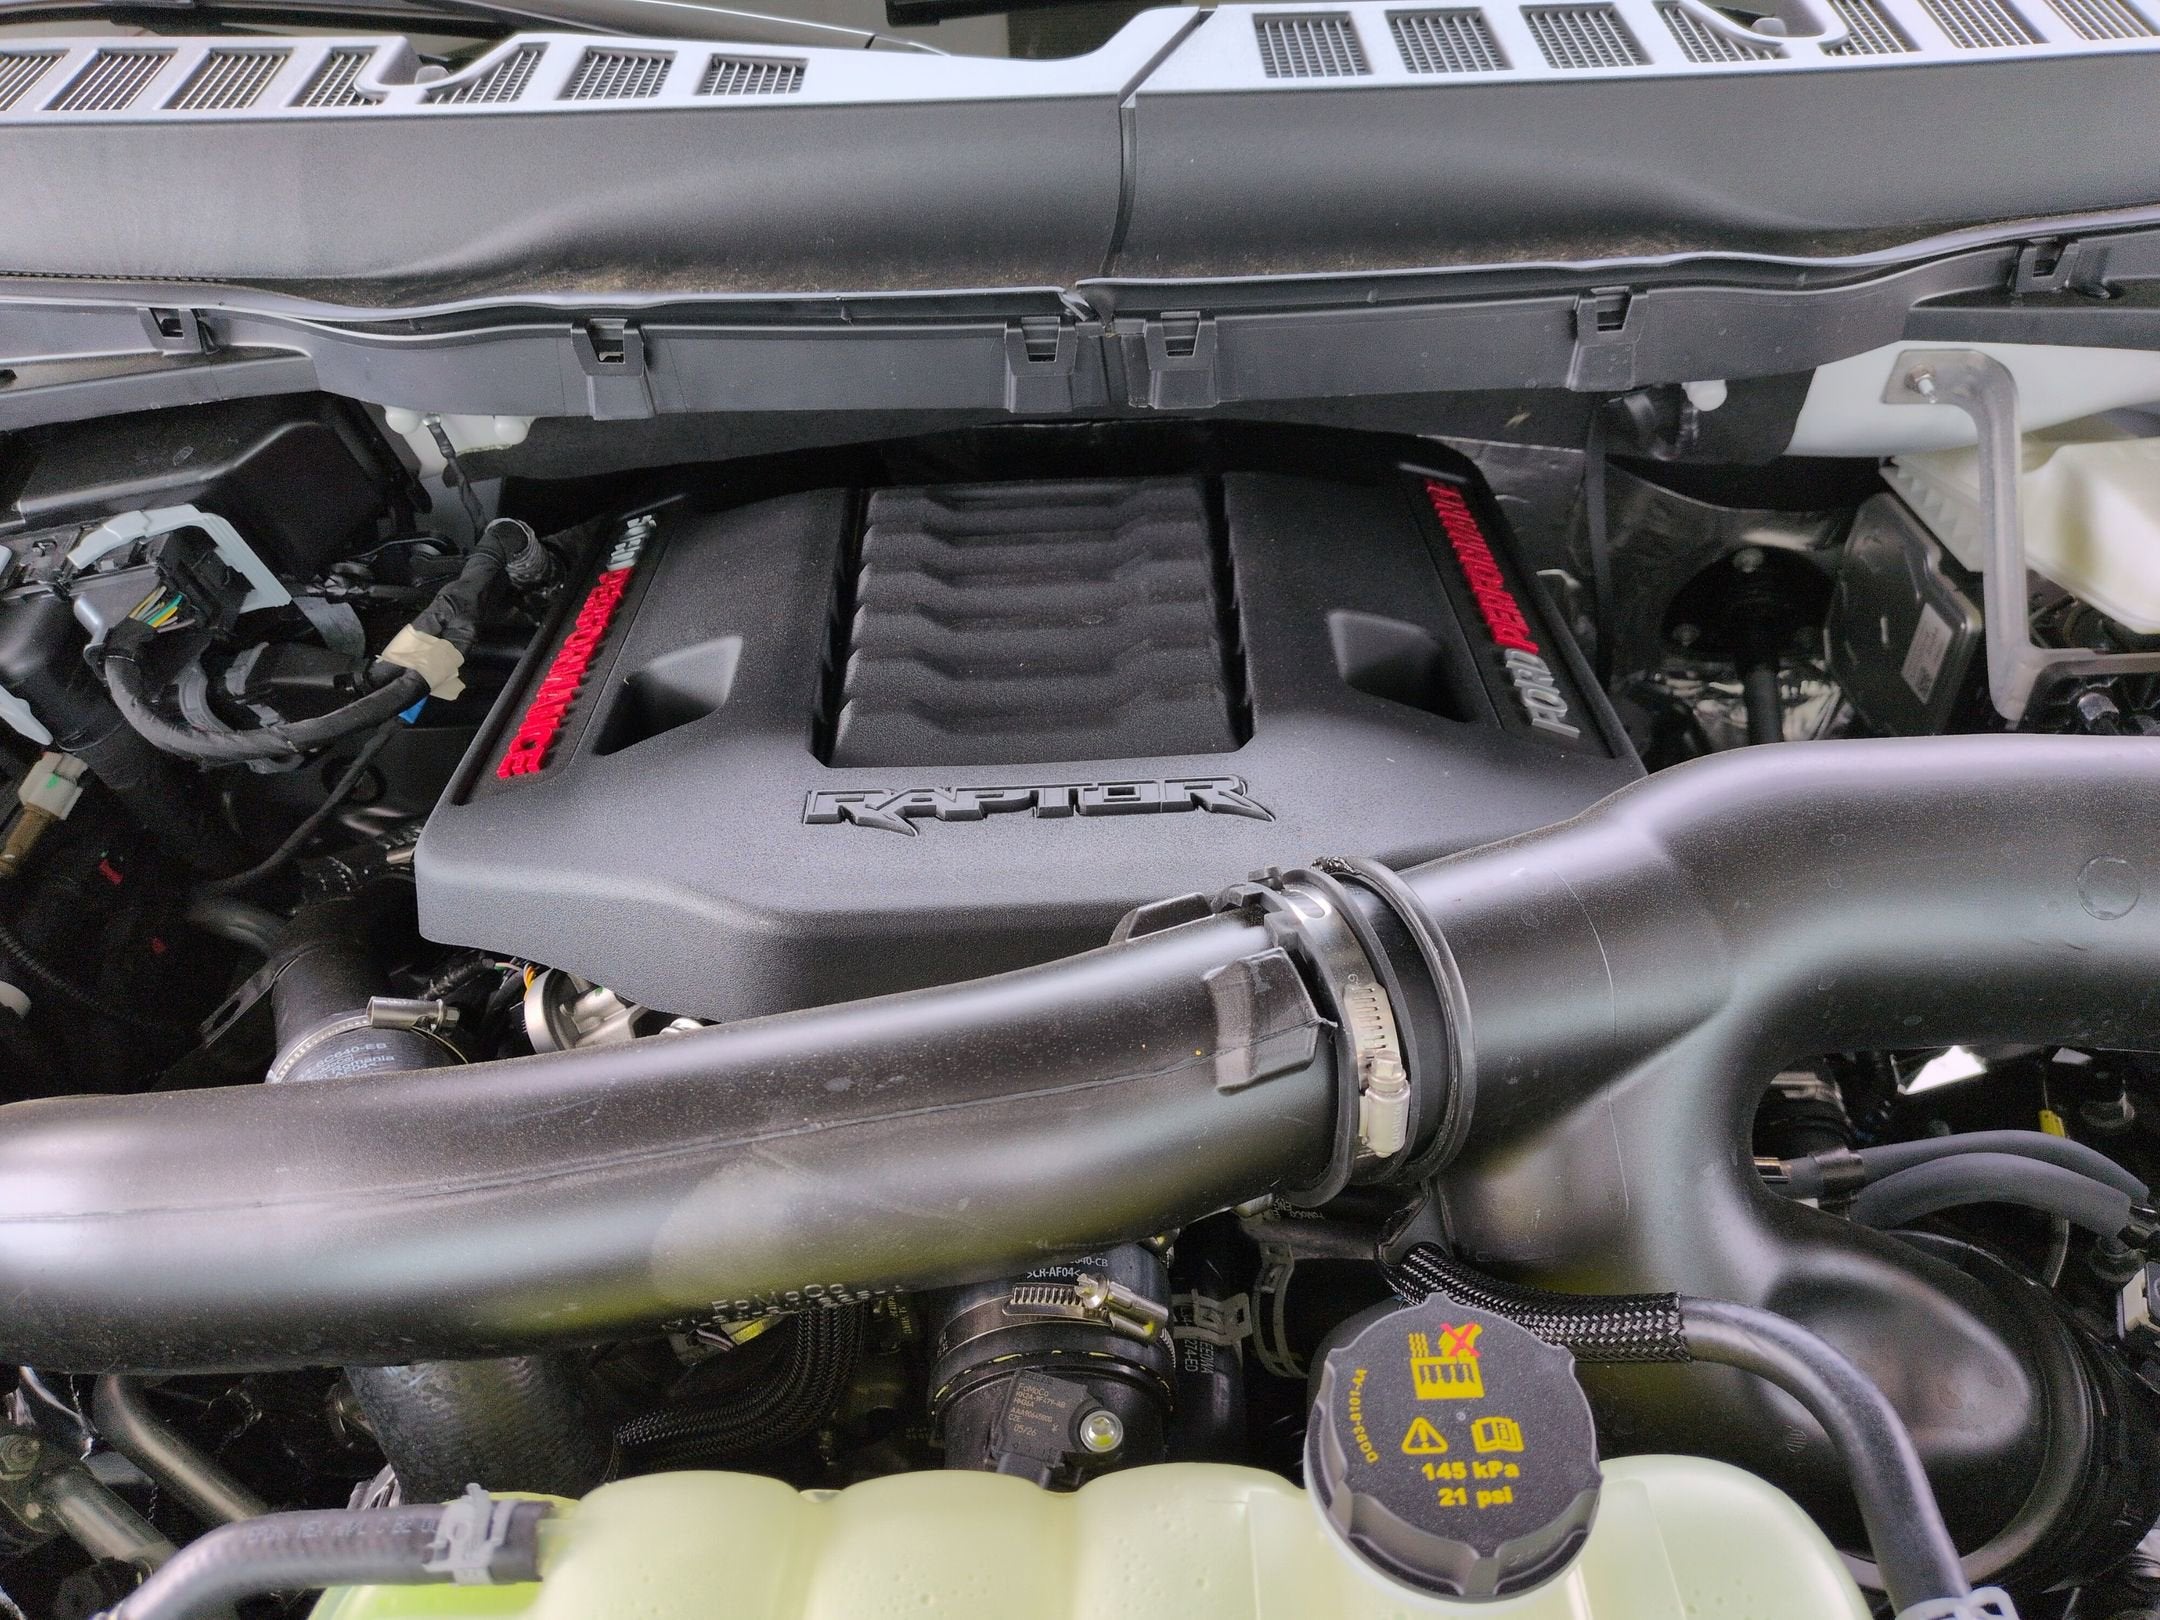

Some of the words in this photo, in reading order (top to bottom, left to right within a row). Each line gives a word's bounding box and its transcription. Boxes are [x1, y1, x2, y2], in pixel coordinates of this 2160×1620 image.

[1426, 479, 1540, 655] PERFORMANCE
[496, 566, 635, 779] PERFORMANCE
[1504, 648, 1580, 739] FORD
[803, 774, 1276, 837] RAPTOR
[1421, 1461, 1467, 1481] 145
[1472, 1460, 1520, 1480] kPa
[1437, 1487, 1468, 1507] 21
[1475, 1486, 1514, 1509] psi
